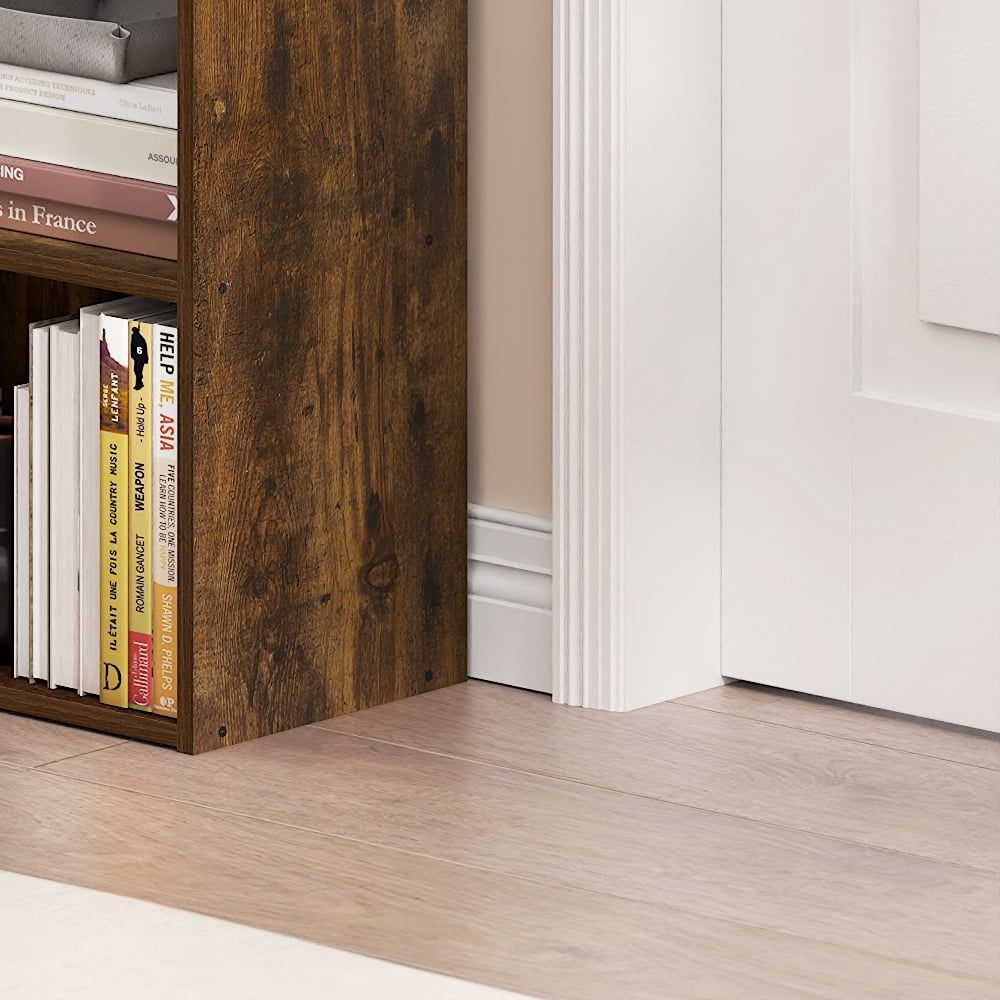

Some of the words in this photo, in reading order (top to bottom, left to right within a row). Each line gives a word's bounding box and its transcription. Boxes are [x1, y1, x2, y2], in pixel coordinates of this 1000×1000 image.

[5, 84, 38, 96] PRODUCT
[39, 89, 66, 101] DESIGN
[51, 82, 96, 96] TECHNIQUES
[7, 200, 27, 222] in
[31, 204, 97, 235] France
[136, 346, 143, 355] 6
[160, 331, 175, 375] HELP
[110, 372, 120, 423] LENFANT
[158, 379, 175, 408] ME,
[137, 402, 147, 415] Up
[136, 417, 145, 437] Hold
[159, 413, 175, 451] ASIA
[109, 443, 117, 476] MUSIC
[134, 462, 145, 511] WEAPON
[167, 464, 175, 483] FIVE
[159, 474, 167, 500] LEARN
[109, 481, 117, 526] COUNTRY
[159, 501, 167, 520] HOW
[109, 531, 117, 544] LA
[159, 521, 167, 531] TO
[159, 533, 167, 543] BE
[167, 531, 175, 548] ONE
[109, 549, 117, 576] FOIS
[135, 533, 145, 574] GANCET
[109, 580, 117, 600] UNE
[135, 575, 145, 613] ROMAIN
[161, 593, 173, 633] SHAWN
[161, 635, 173, 646] D.
[133, 641, 149, 706] Gallimard
[161, 649, 173, 691] PHELPS
